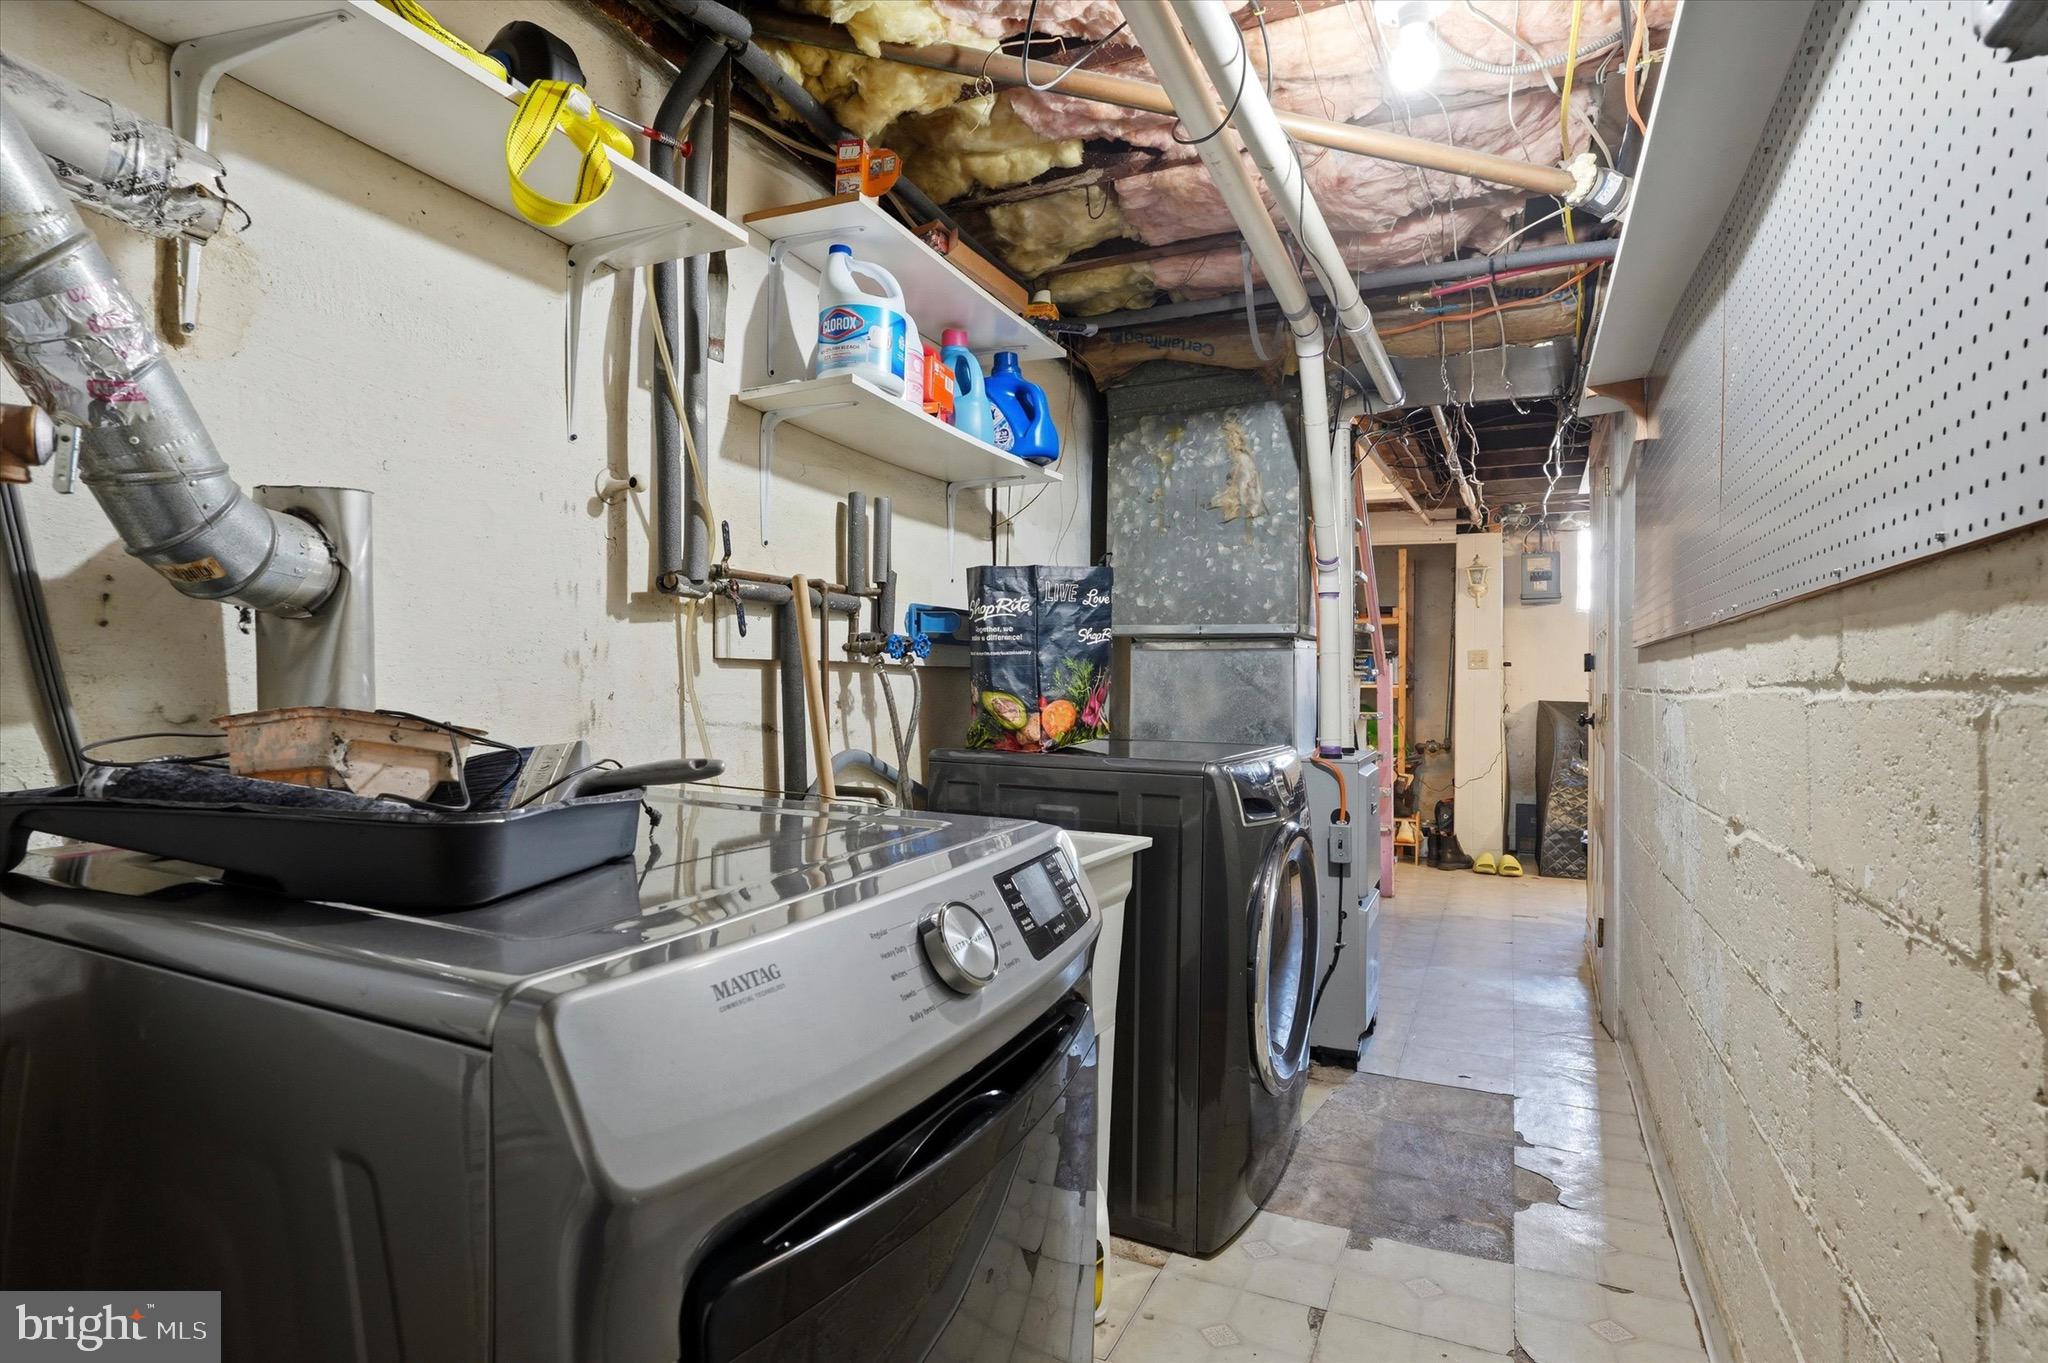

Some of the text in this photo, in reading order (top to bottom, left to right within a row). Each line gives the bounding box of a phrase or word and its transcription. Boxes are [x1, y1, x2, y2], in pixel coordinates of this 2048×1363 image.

[822, 316, 857, 335] CLOROX
[1044, 581, 1079, 603] LIVE
[1082, 588, 1110, 608] Love
[968, 596, 1030, 621] ShopRite
[869, 928, 888, 940] Regular
[710, 963, 782, 1002] MAYTAG
[909, 1009, 924, 1022] Bulky
